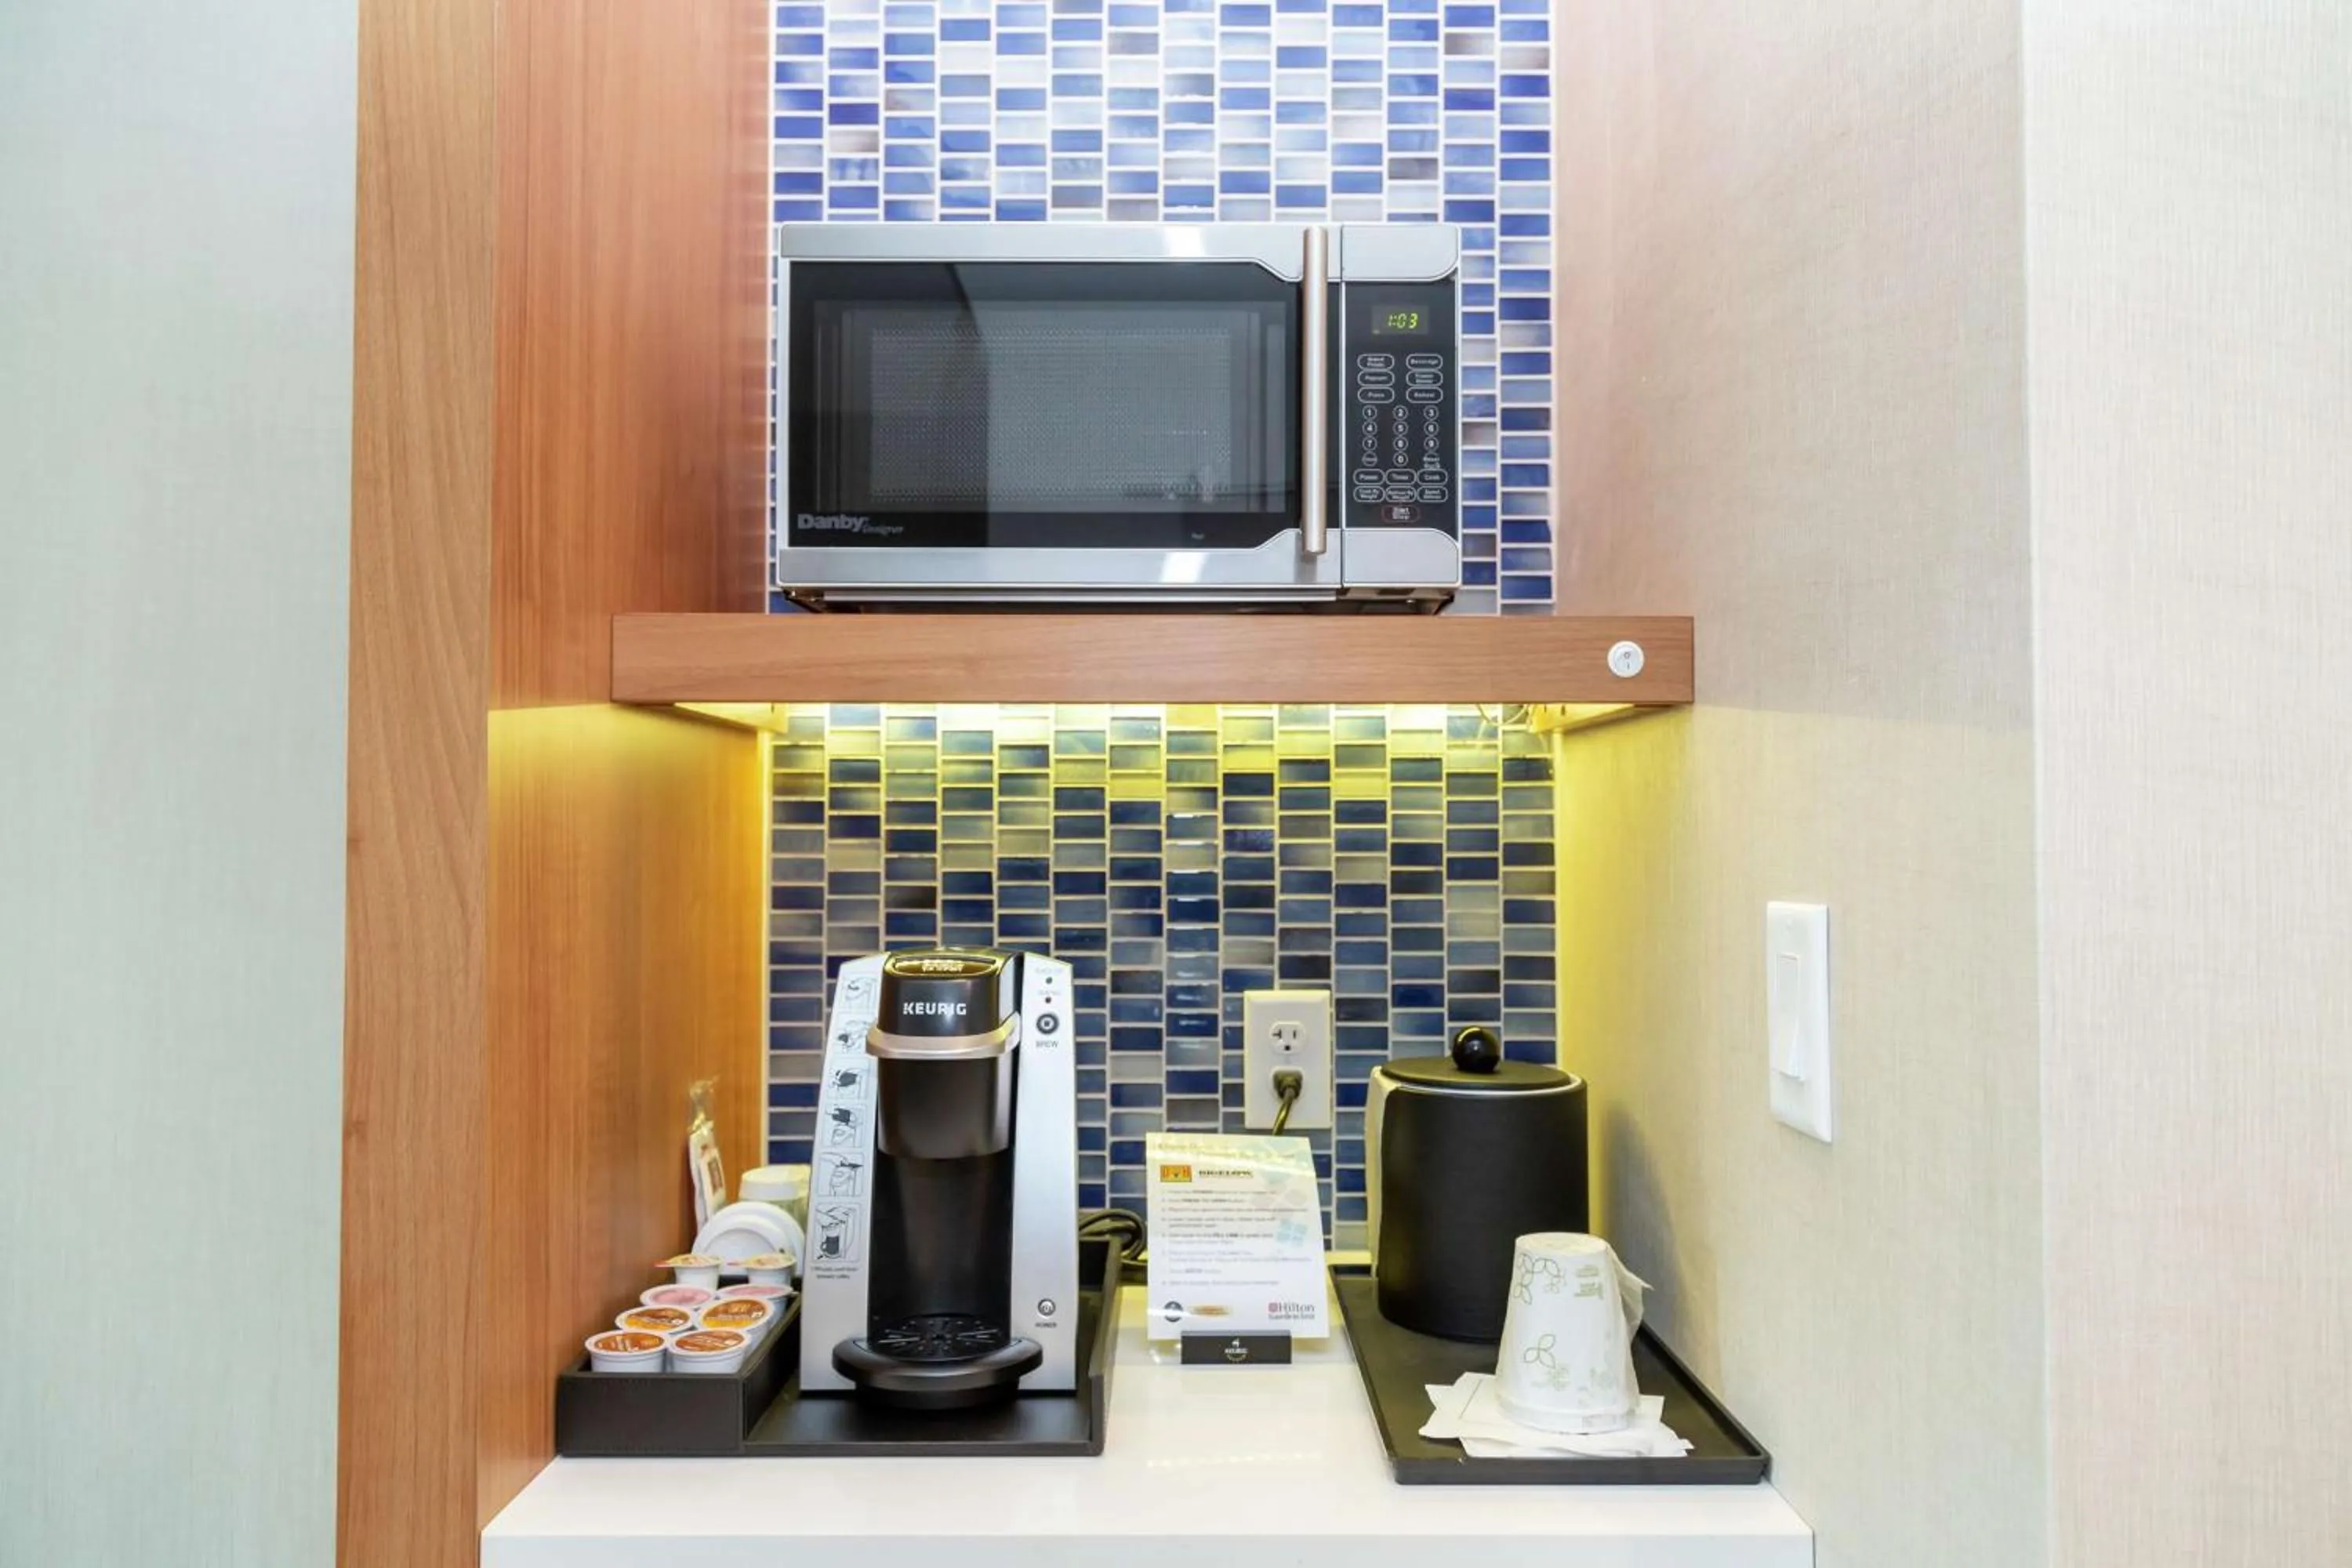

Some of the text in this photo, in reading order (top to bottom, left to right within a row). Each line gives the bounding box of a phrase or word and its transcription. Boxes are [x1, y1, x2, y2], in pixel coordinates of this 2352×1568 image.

[1388, 313, 1418, 328] 1:03
[797, 514, 863, 532] Danby
[903, 1002, 967, 1015] KEURIG
[1278, 1301, 1315, 1312] Hilton
